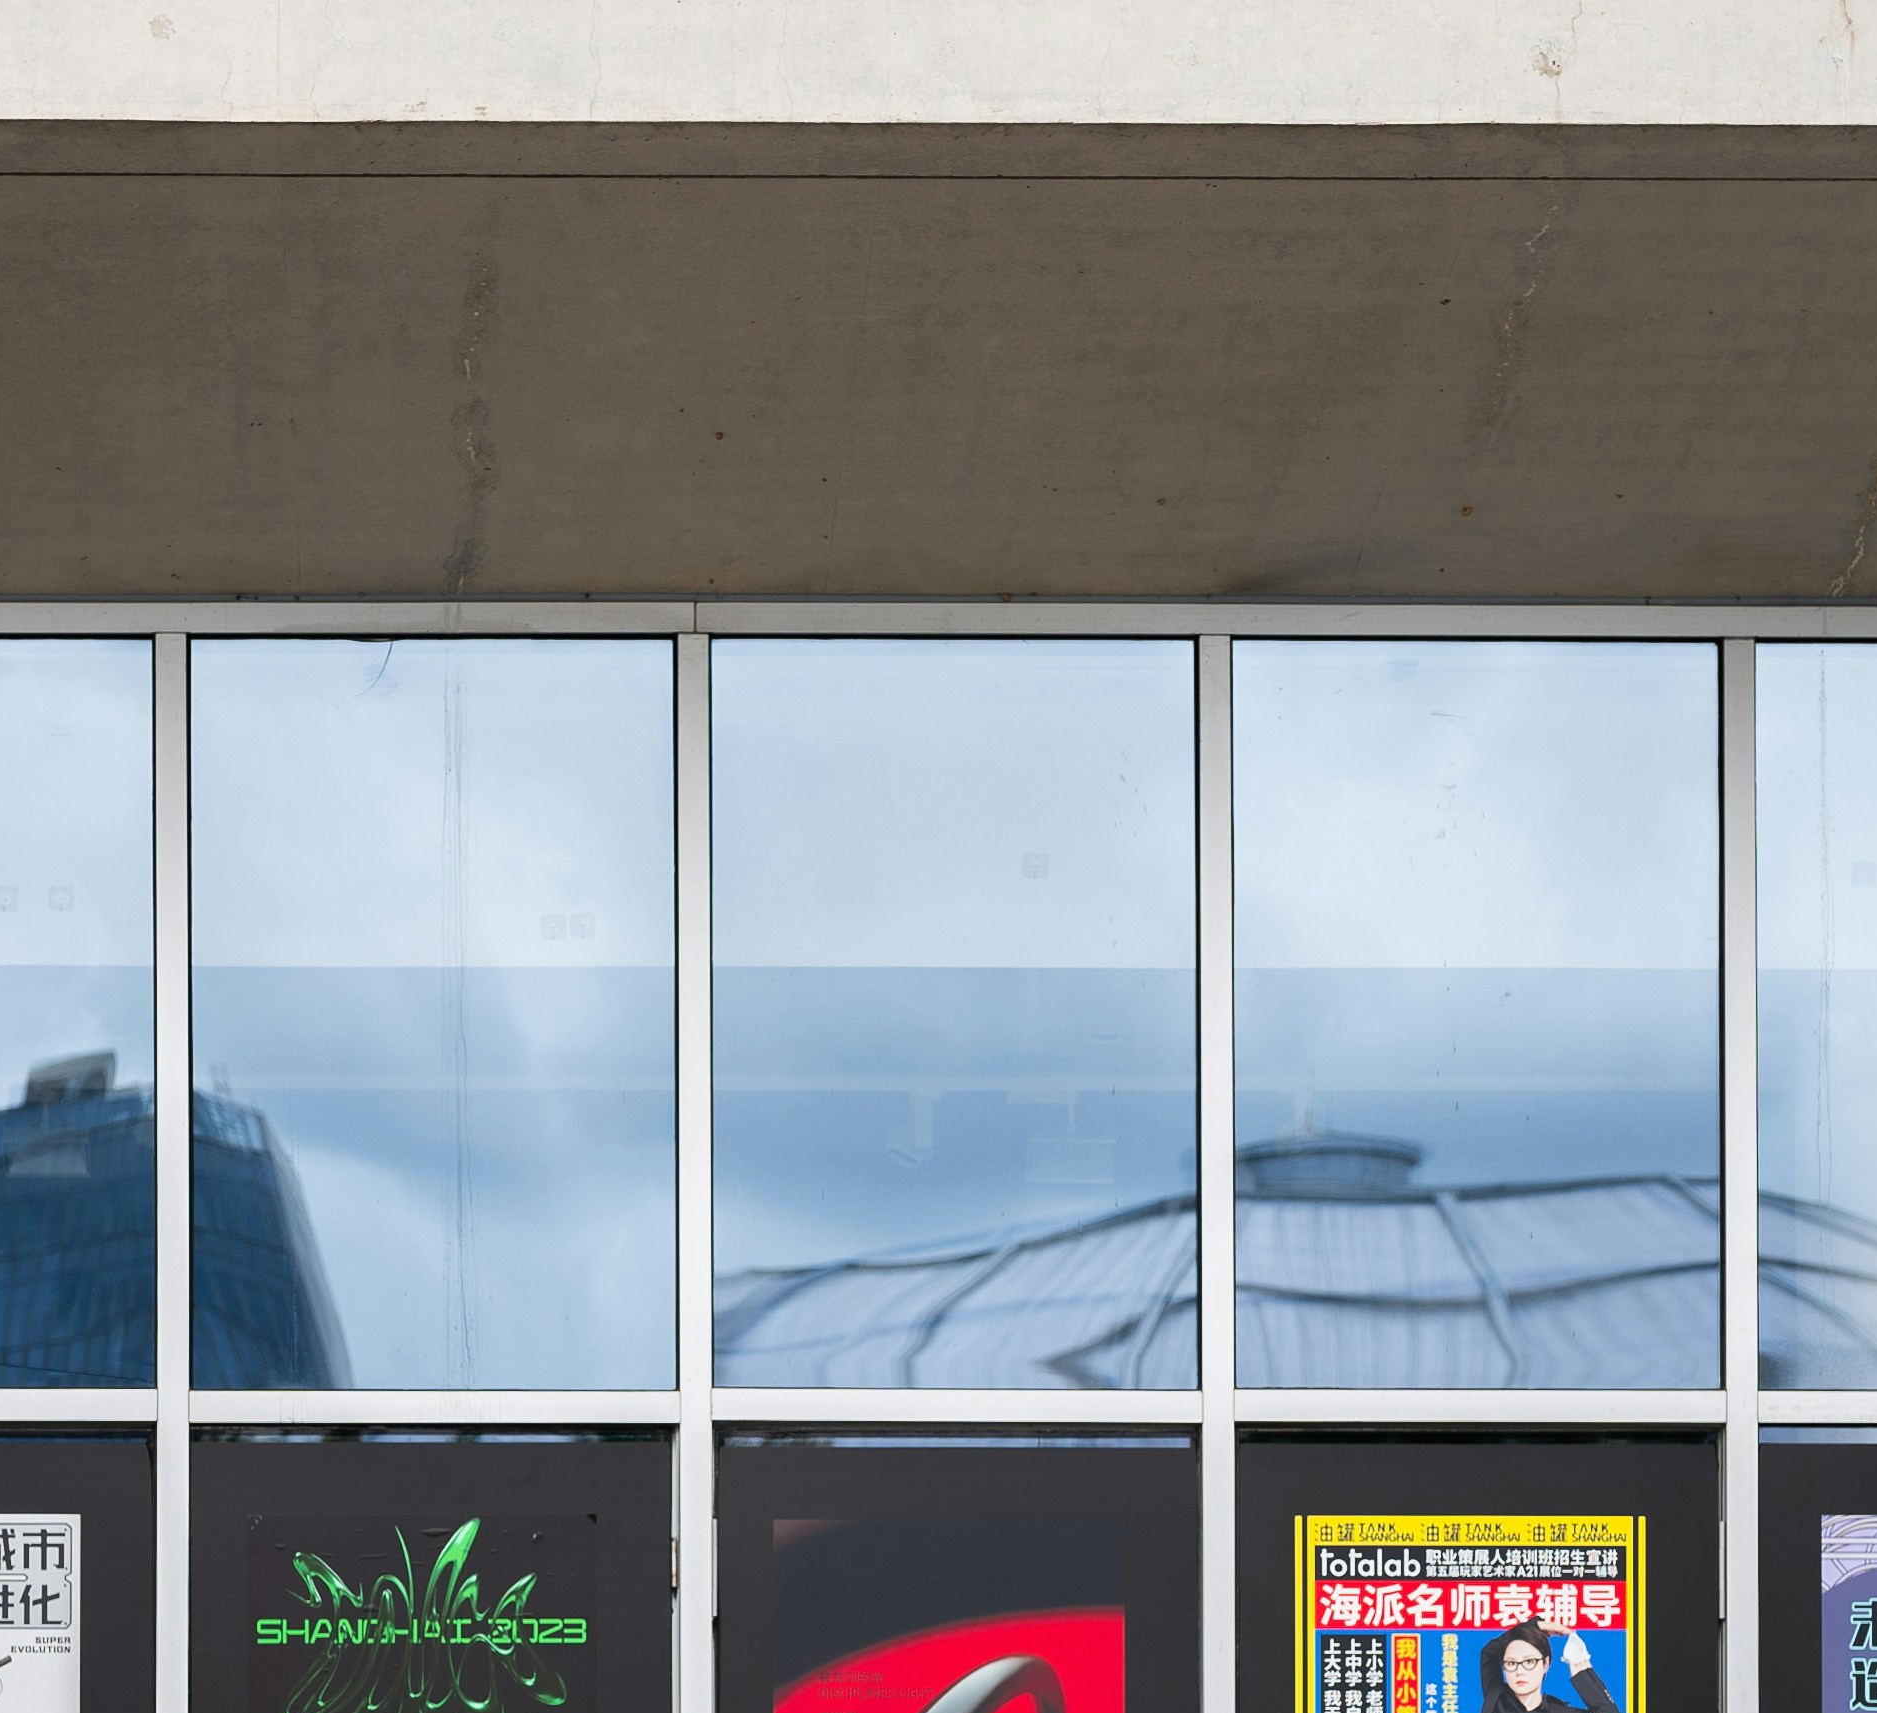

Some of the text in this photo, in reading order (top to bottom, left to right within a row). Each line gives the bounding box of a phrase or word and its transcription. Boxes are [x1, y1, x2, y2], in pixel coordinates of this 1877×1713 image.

[1315, 1523, 1396, 1542] 油罐 TANK
[1359, 1533, 1414, 1542] SHANGHAI
[1421, 1523, 1503, 1542] 油罐 TANK
[1465, 1533, 1521, 1542] SHANGHAI
[1527, 1523, 1609, 1542] 油罐 TANK
[1572, 1533, 1627, 1542] SHANGHAI
[1320, 1548, 1421, 1577] totalab
[1320, 1582, 1622, 1628] 海派名师袁辅导
[256, 1618, 472, 1644] SHANGHAI
